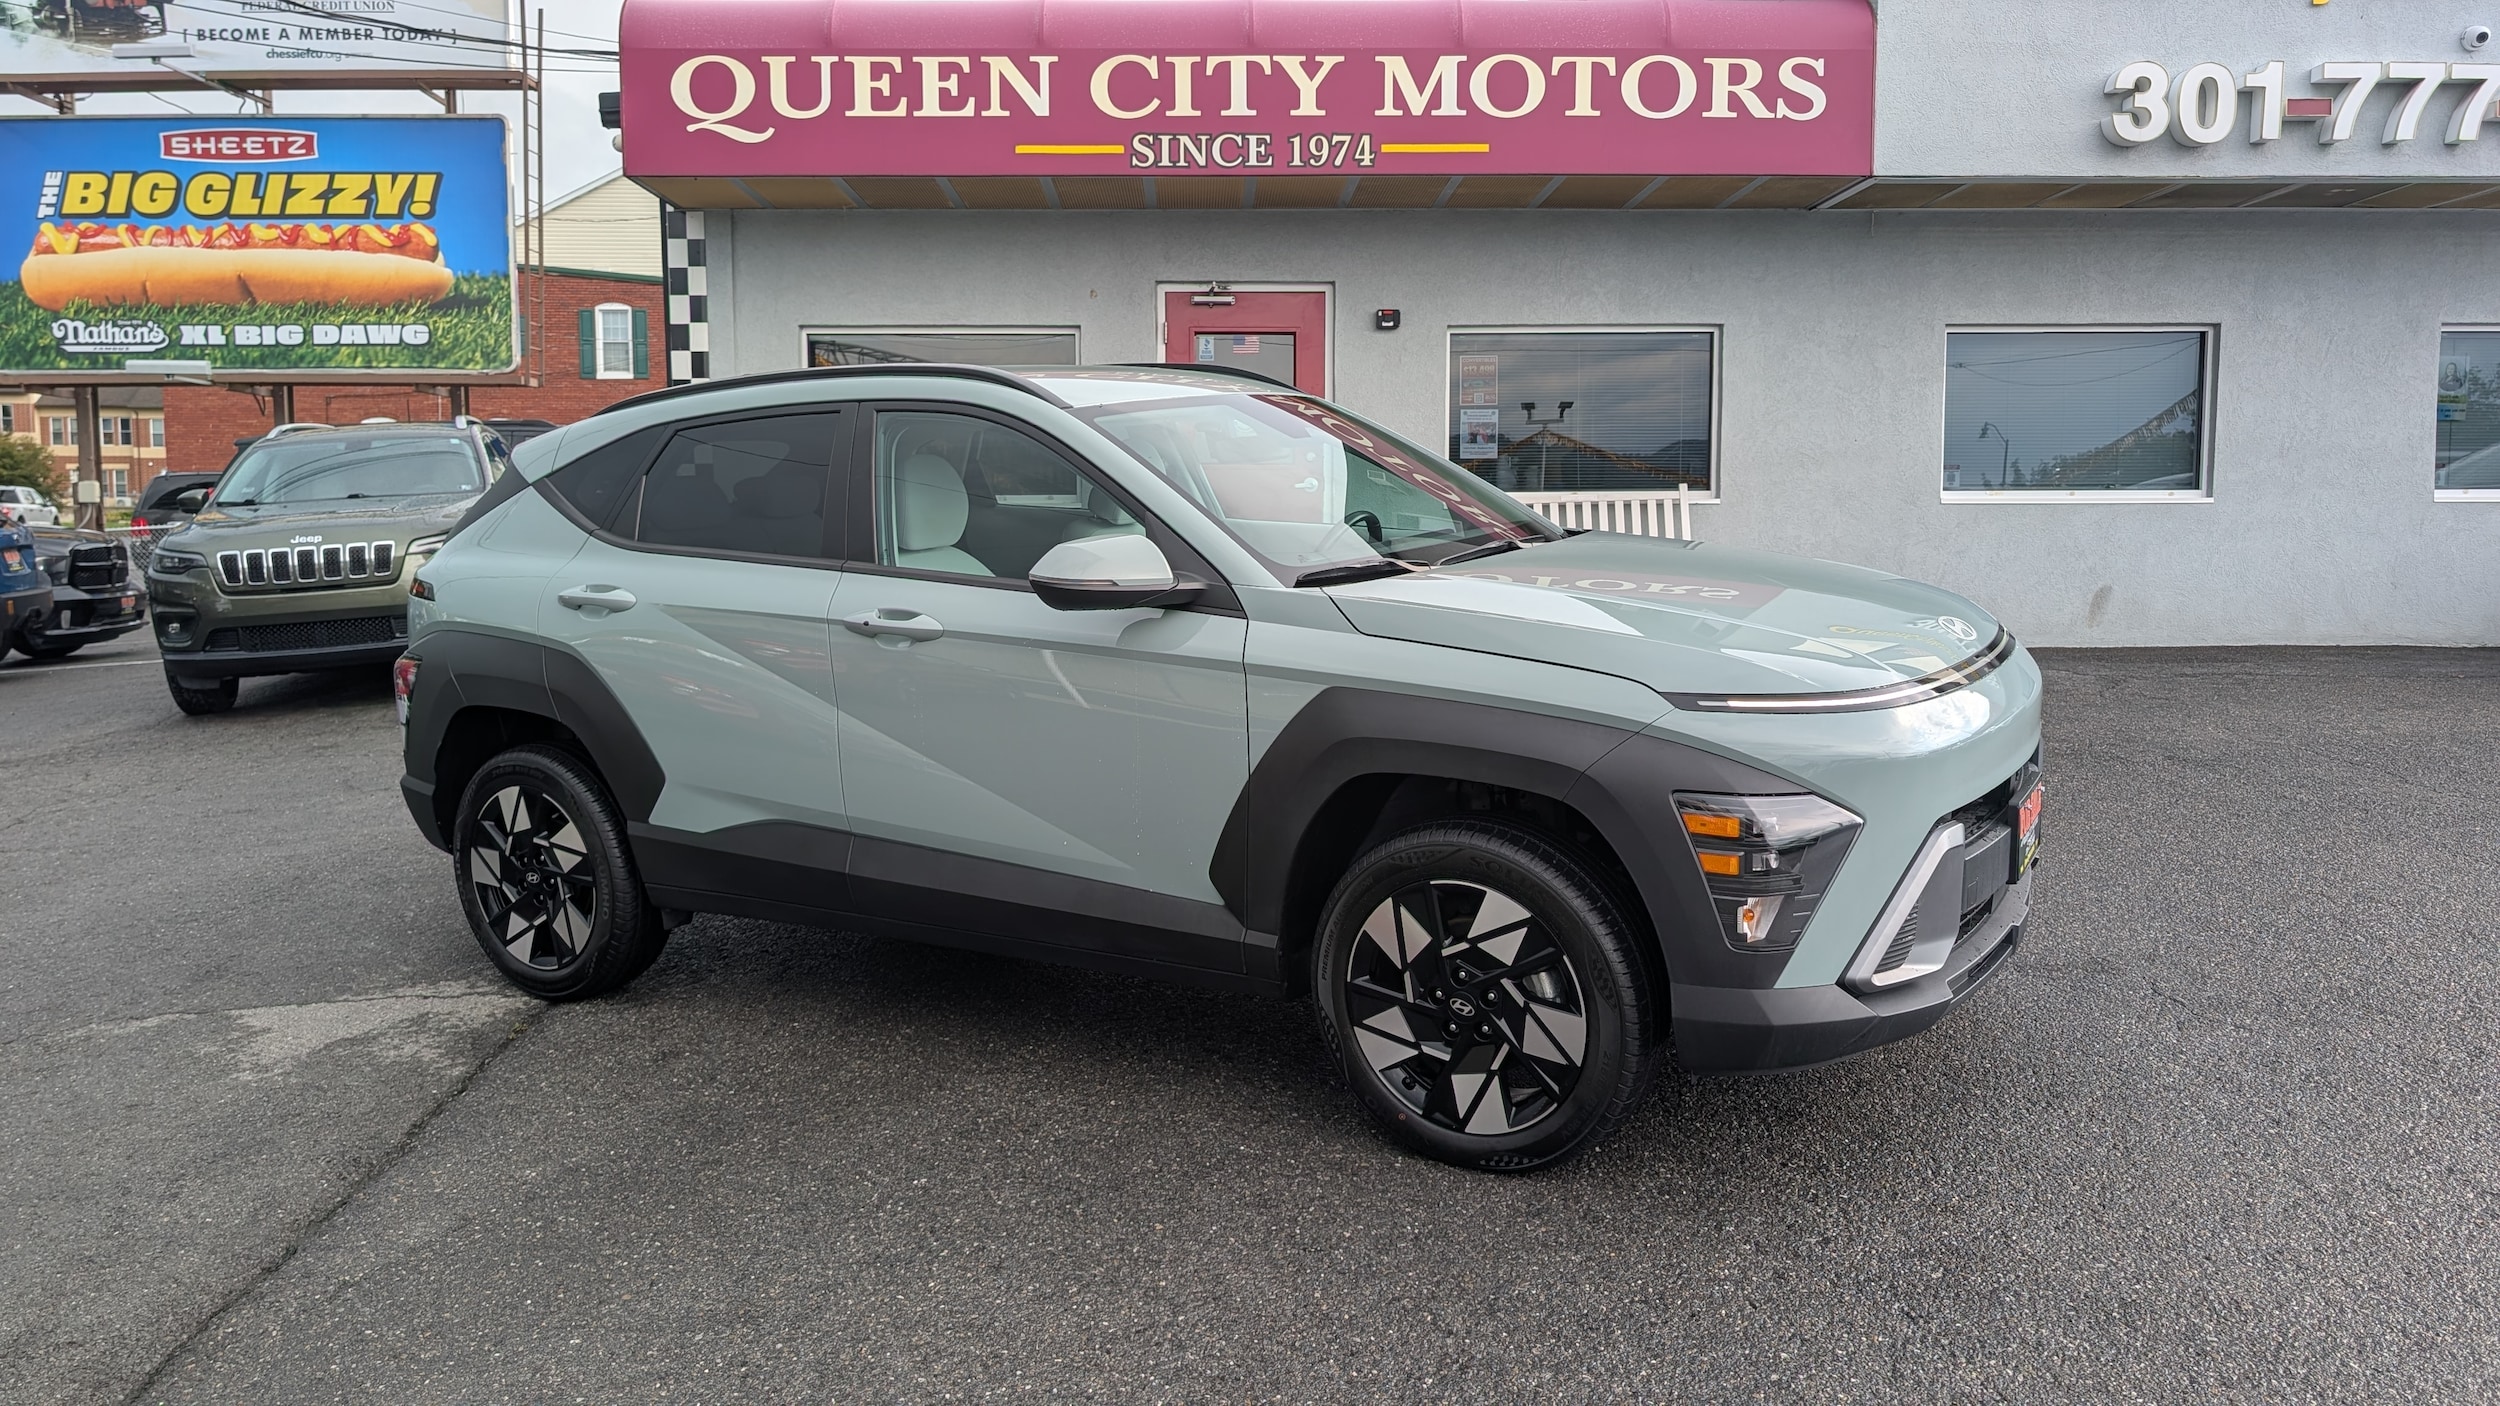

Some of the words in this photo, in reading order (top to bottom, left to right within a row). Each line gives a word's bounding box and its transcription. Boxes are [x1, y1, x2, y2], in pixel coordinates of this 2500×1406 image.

[354, 1, 394, 11] UNION
[197, 28, 270, 41] BECOME
[279, 28, 290, 40] A
[300, 28, 374, 41] MEMBER
[265, 48, 342, 62] chessiefcu.org
[669, 54, 1059, 144] QUEEN
[1089, 53, 1345, 120] CITY
[1374, 53, 1828, 121] MOTORS
[2102, 60, 2500, 146] 301-777
[171, 136, 306, 155] SHEETZ
[1130, 134, 1274, 168] SINCE
[1287, 134, 1376, 168] 1974
[36, 171, 63, 219] THE
[60, 171, 179, 216] BIG
[184, 171, 438, 216] GLIZZY!
[51, 319, 165, 344] Nathan's
[179, 325, 227, 345] XL
[234, 325, 304, 345] BIG
[312, 325, 430, 345] DAWG
[290, 534, 323, 544] Jeep
[1320, 928, 1338, 982] PREMIUM
